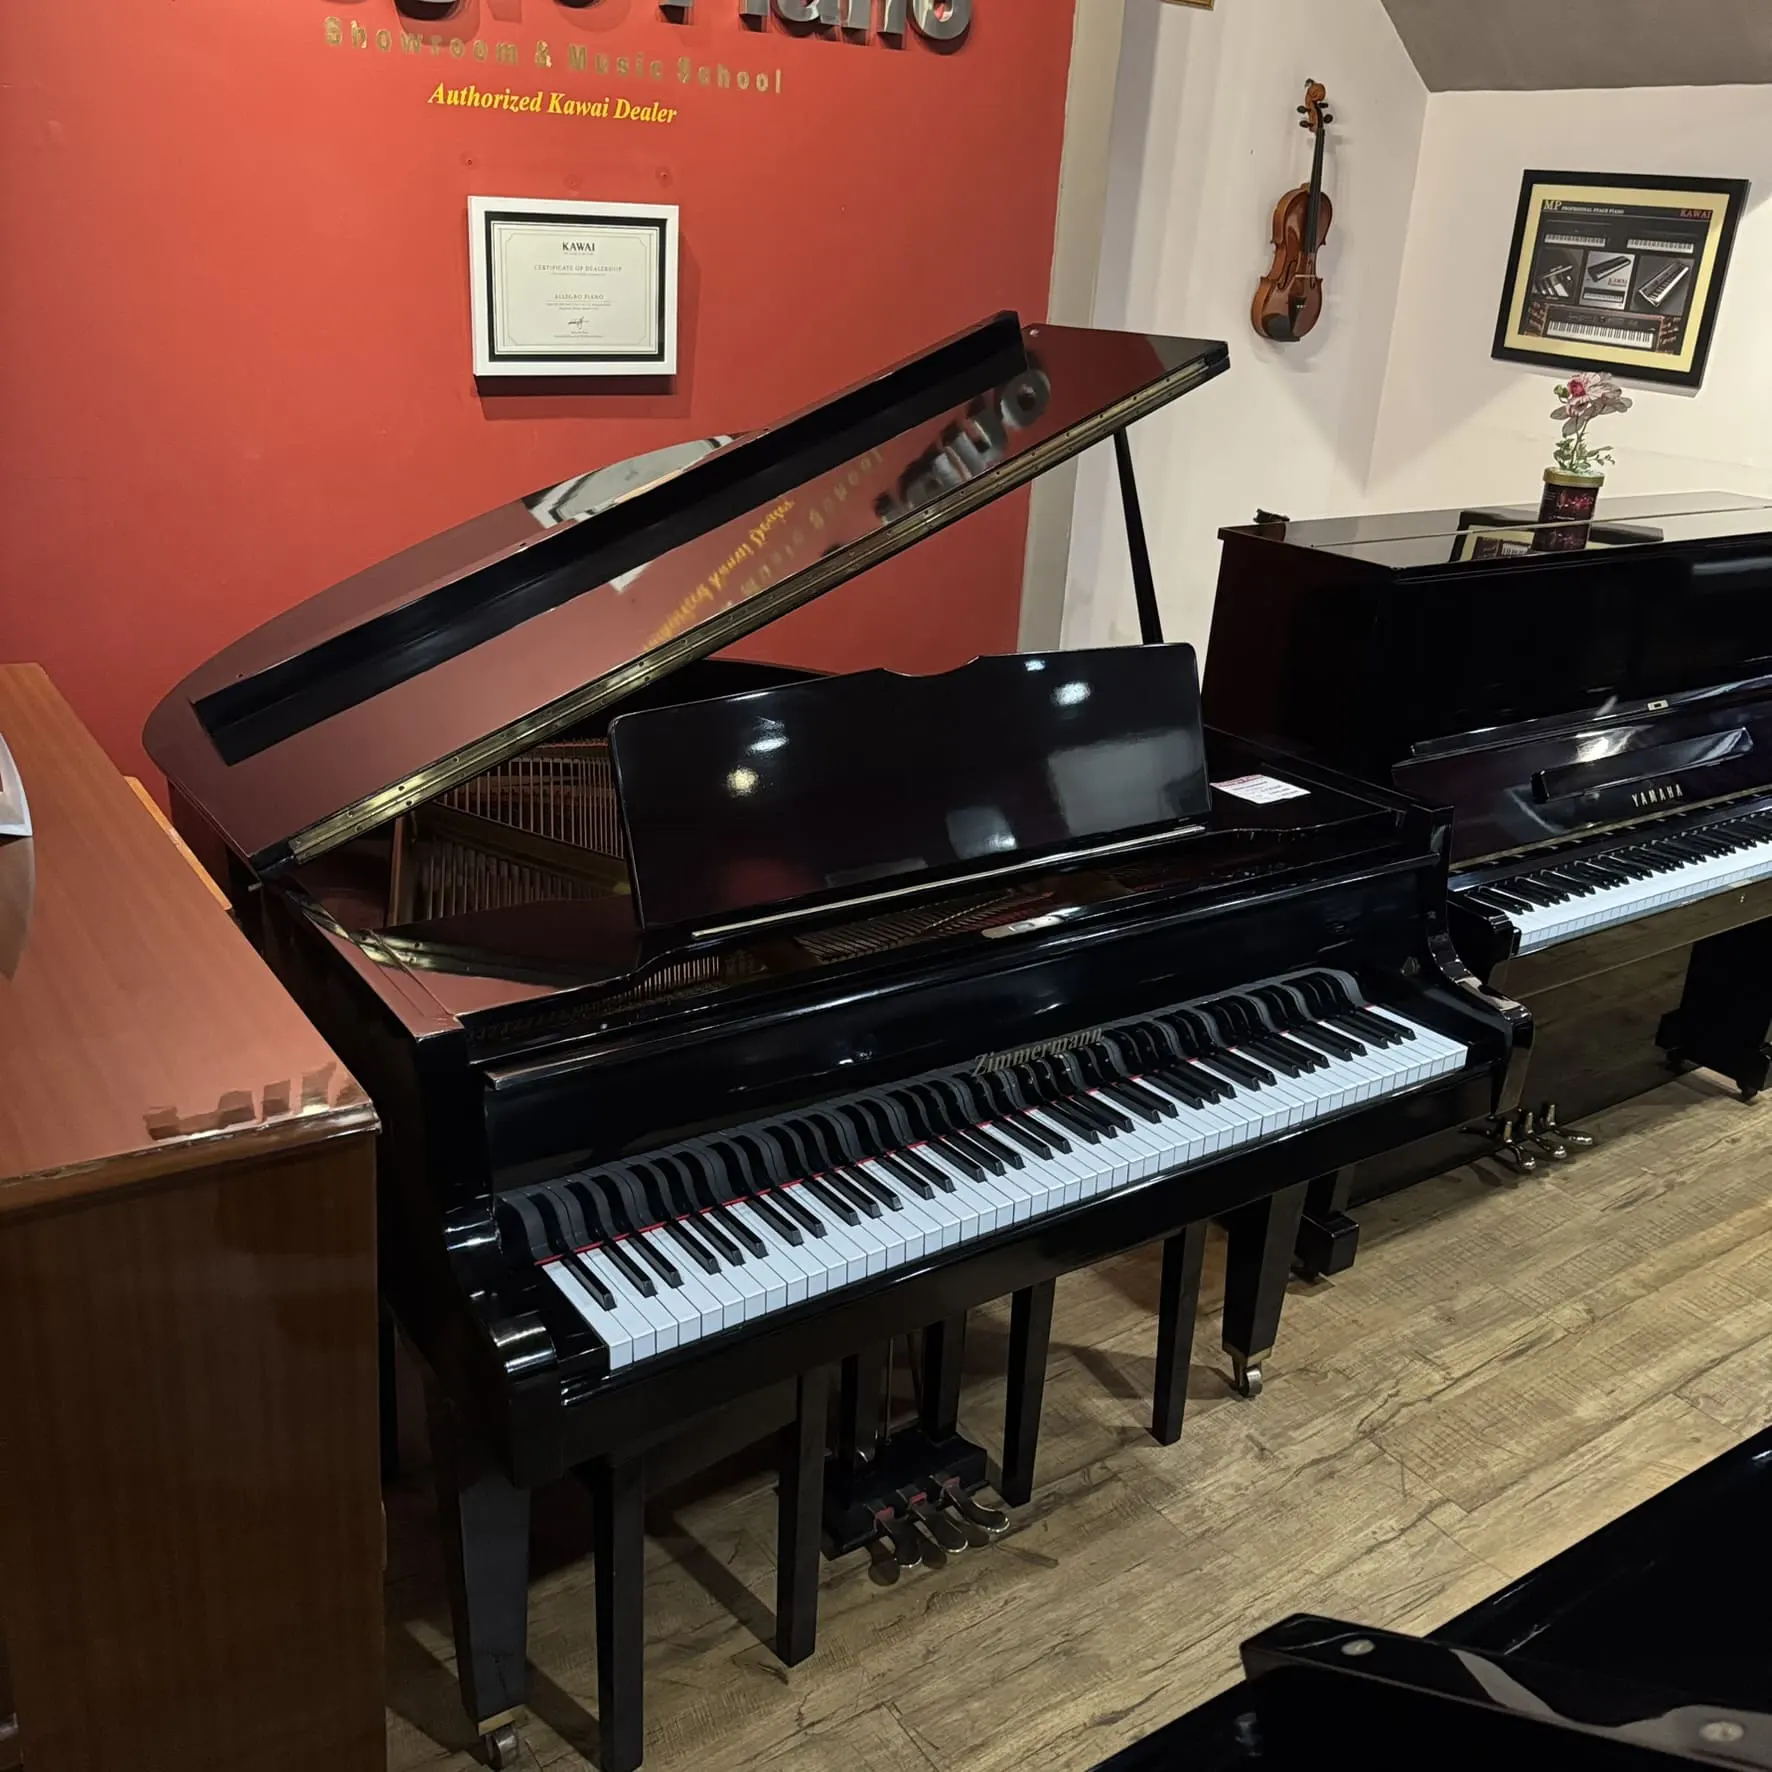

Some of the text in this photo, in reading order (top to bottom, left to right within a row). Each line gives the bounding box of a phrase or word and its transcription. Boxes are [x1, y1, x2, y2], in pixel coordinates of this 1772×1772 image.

[324, 16, 782, 94] Showroom & Music School
[427, 82, 678, 123] Authorized Kawai Dealer
[1543, 200, 1562, 211] MP
[1680, 209, 1711, 219] KAWAI
[562, 241, 595, 252] KAWAI
[1631, 783, 1683, 807] YAMAHA
[971, 1028, 1104, 1077] Zimmermann
